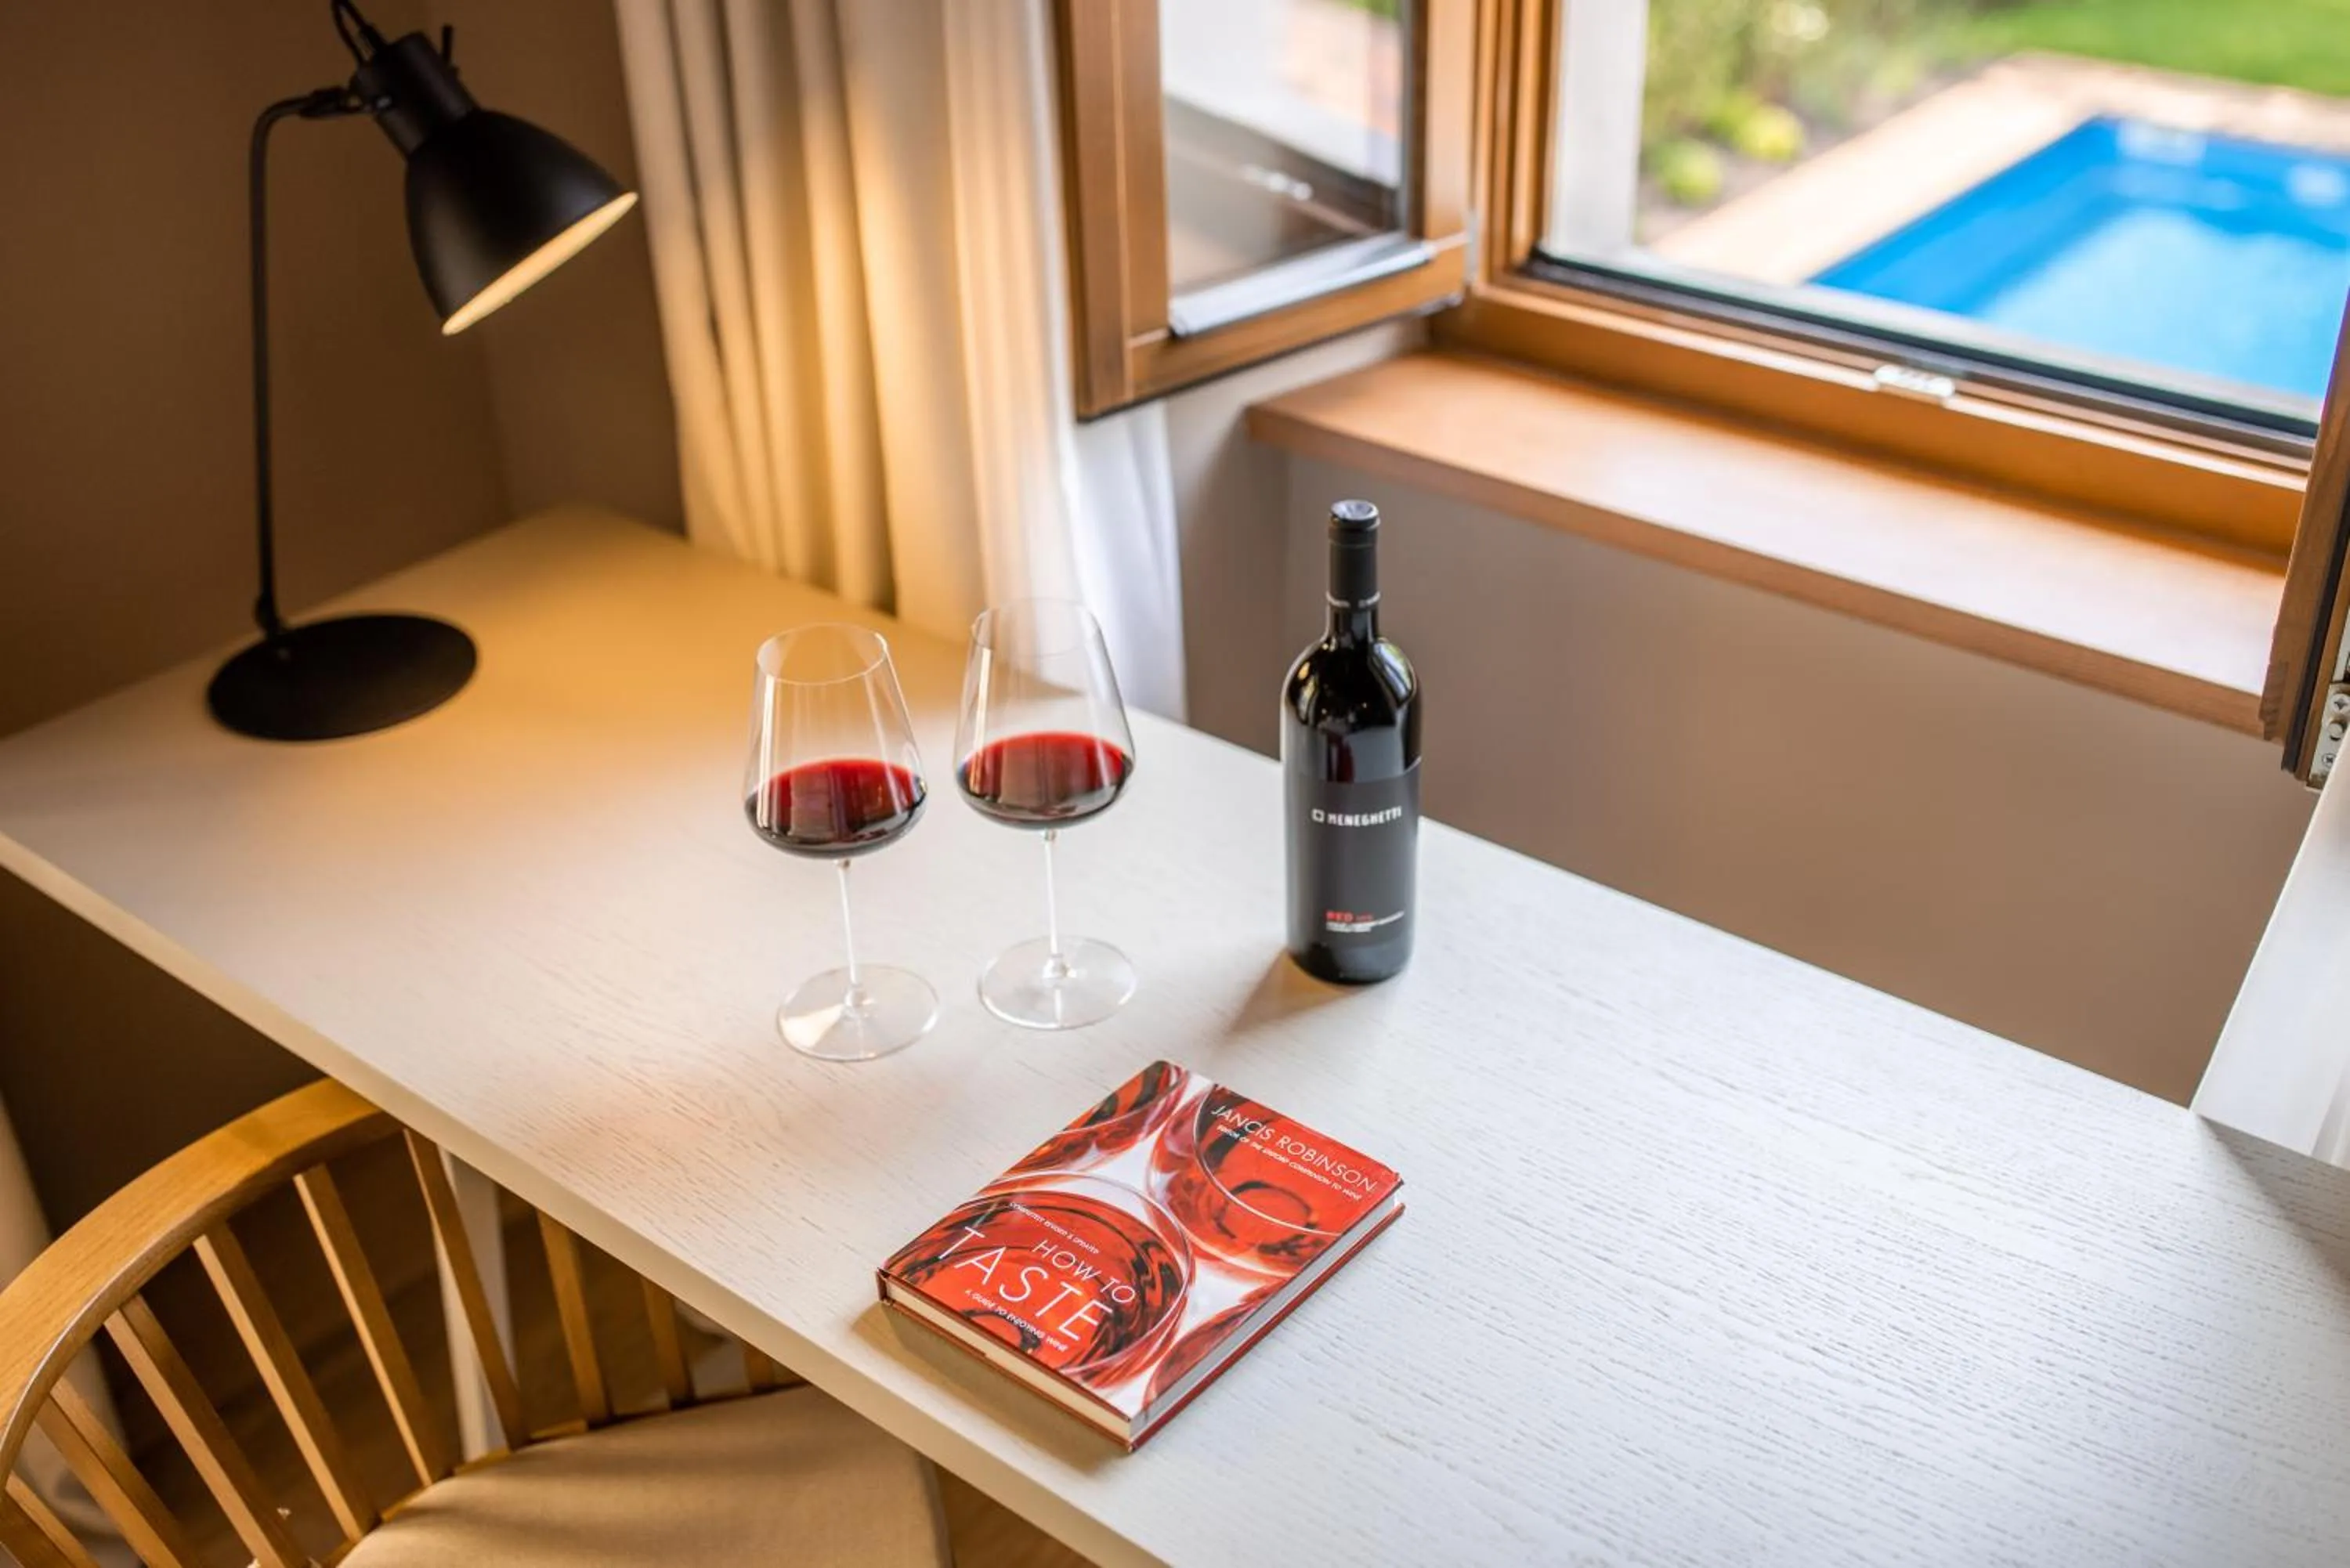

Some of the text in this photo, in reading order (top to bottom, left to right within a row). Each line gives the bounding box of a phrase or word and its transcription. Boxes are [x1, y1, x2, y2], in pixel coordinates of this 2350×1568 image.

[1327, 806, 1402, 826] MENEGHETTI
[1211, 1105, 1378, 1192] JANCIS ROBINSON
[938, 1226, 1113, 1341] TASTE
[1032, 1240, 1136, 1303] HOW TO
[994, 1306, 1008, 1315] TO
